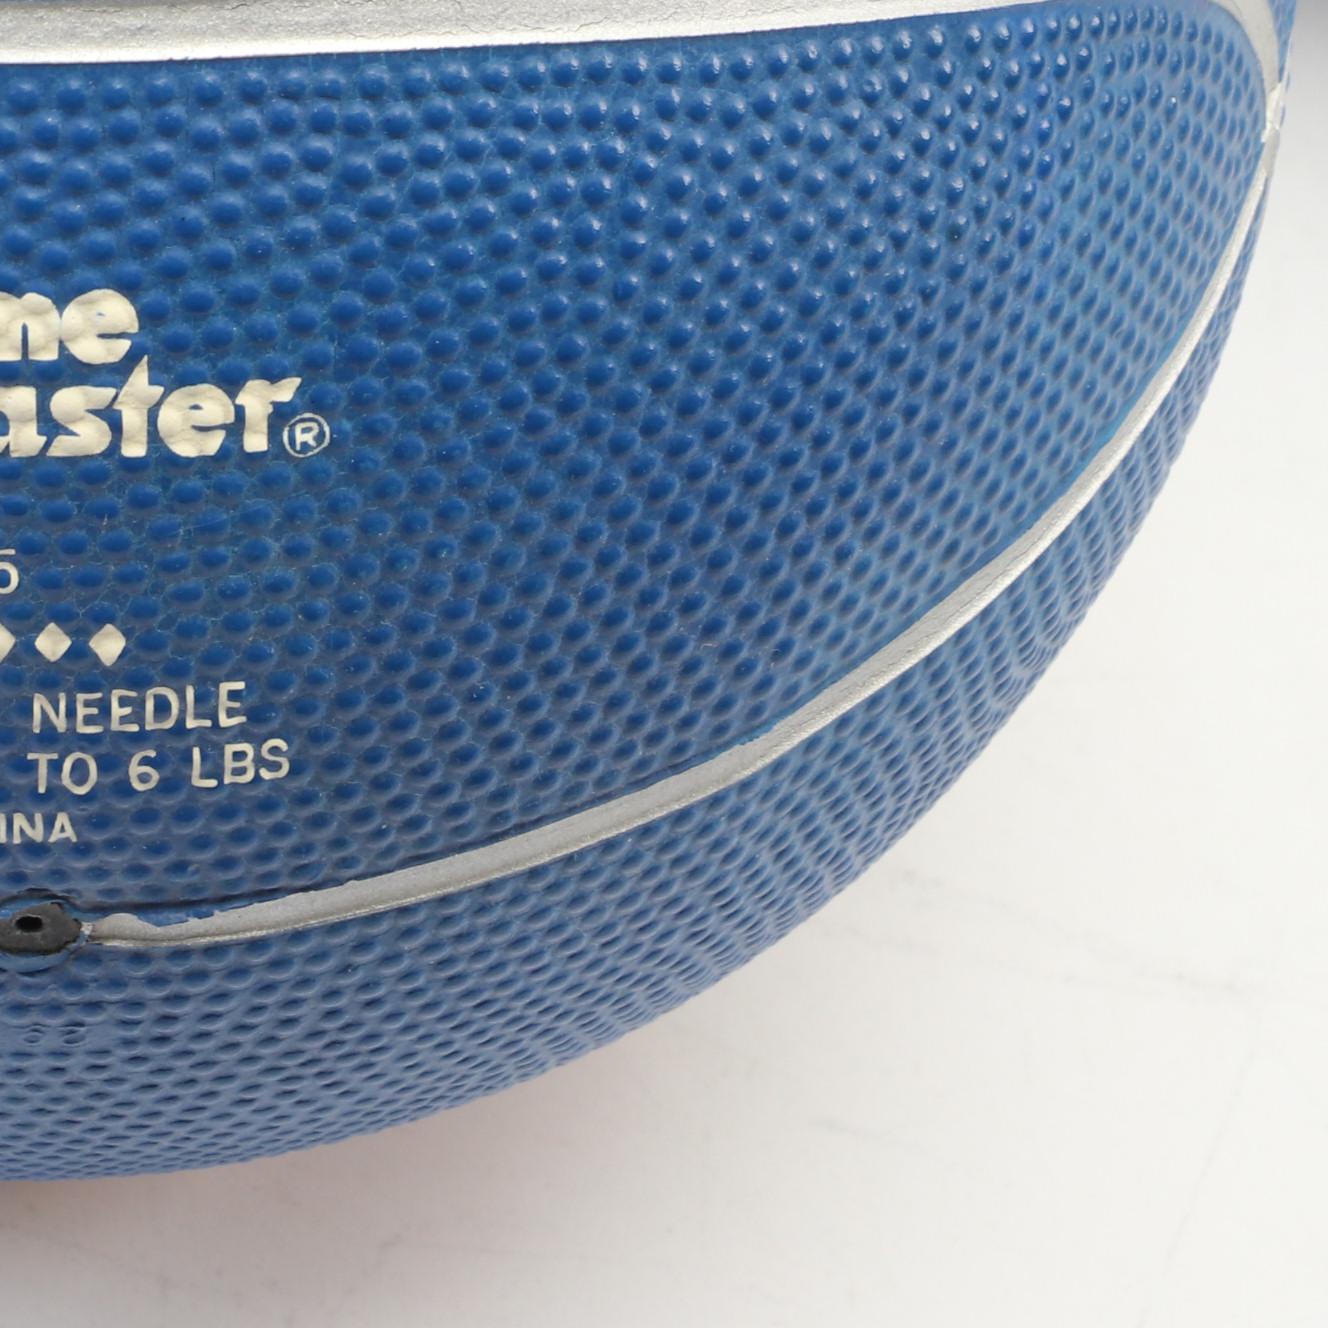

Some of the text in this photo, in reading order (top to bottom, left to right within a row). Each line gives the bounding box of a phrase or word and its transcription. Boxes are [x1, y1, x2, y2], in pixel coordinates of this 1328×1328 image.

[32, 680, 248, 735] NEEDLE
[27, 751, 99, 796] TO
[128, 748, 161, 792] 6
[190, 738, 291, 789] LBS
